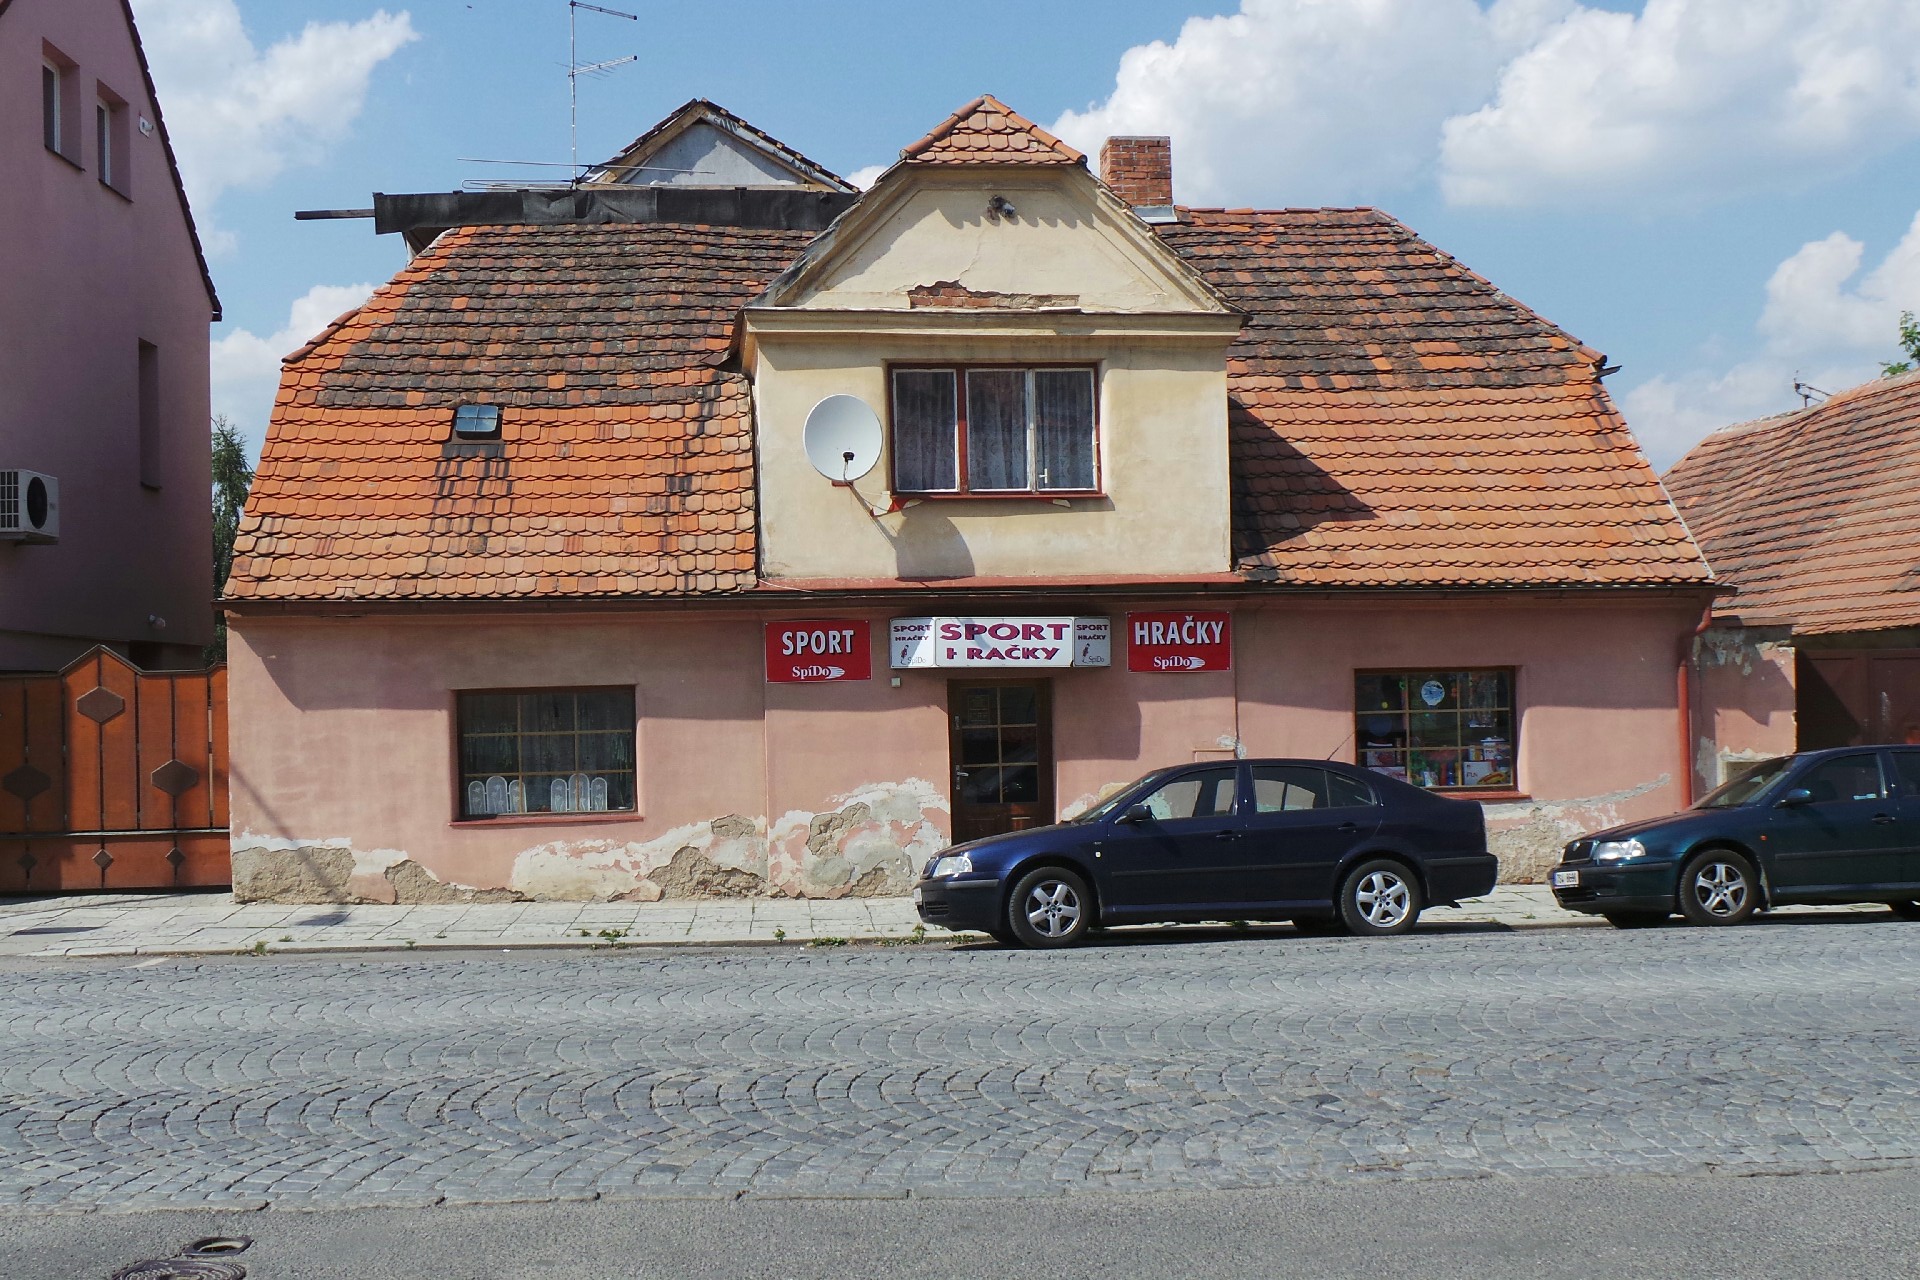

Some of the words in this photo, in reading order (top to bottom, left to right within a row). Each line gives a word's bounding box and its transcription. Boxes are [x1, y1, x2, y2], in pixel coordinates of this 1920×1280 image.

[893, 624, 932, 633] SPORT
[940, 623, 1070, 641] SPORT
[1134, 615, 1224, 645] HRAČKY
[782, 629, 855, 656] SPORT
[895, 634, 929, 642] HRAČKY
